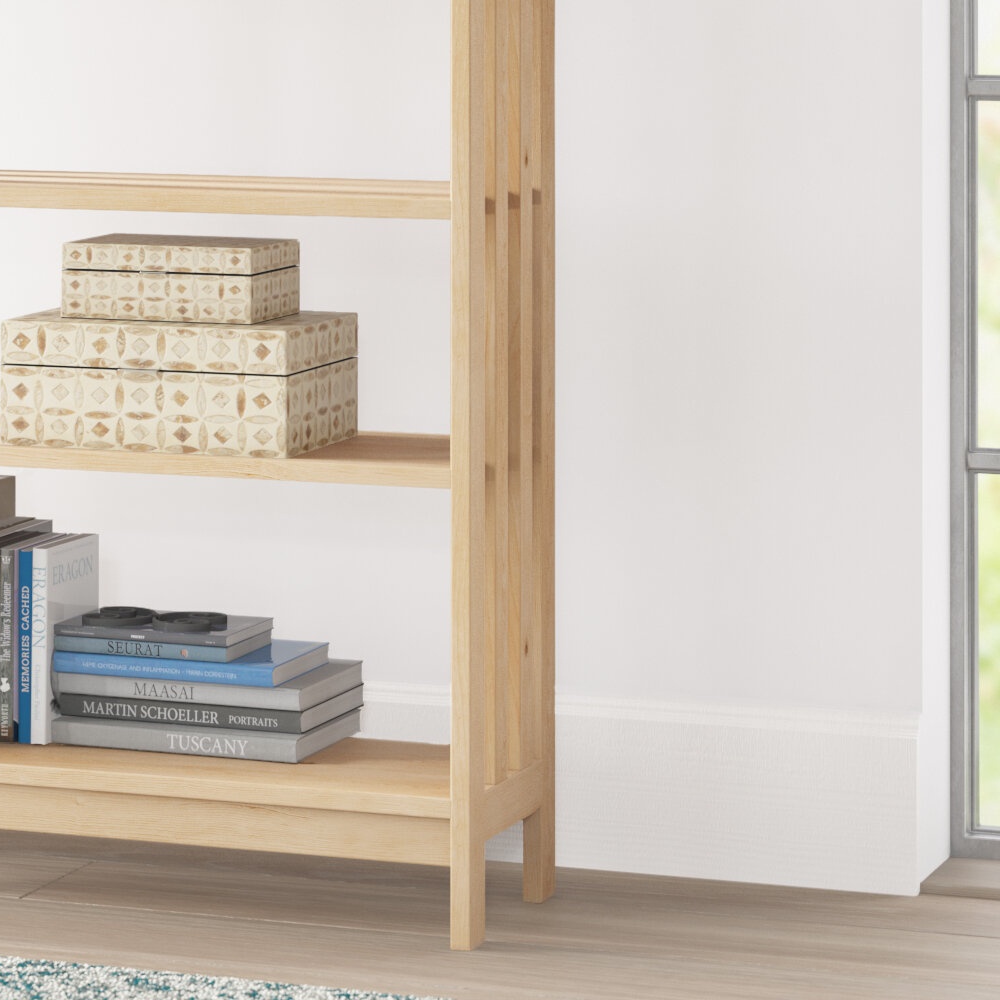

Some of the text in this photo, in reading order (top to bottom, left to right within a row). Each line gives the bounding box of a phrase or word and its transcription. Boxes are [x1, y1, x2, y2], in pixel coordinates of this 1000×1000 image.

[53, 554, 93, 586] ERAGON
[0, 582, 12, 662] The Widow's Redeemer
[32, 567, 47, 648] ERAGON
[21, 586, 30, 693] MEMORIES CACHED
[107, 640, 163, 657] SEURAT
[133, 682, 195, 700] MAASAI
[82, 700, 278, 728] MARTIN SCHOELLER PORTRAITS
[166, 733, 249, 756] TUSCANY
